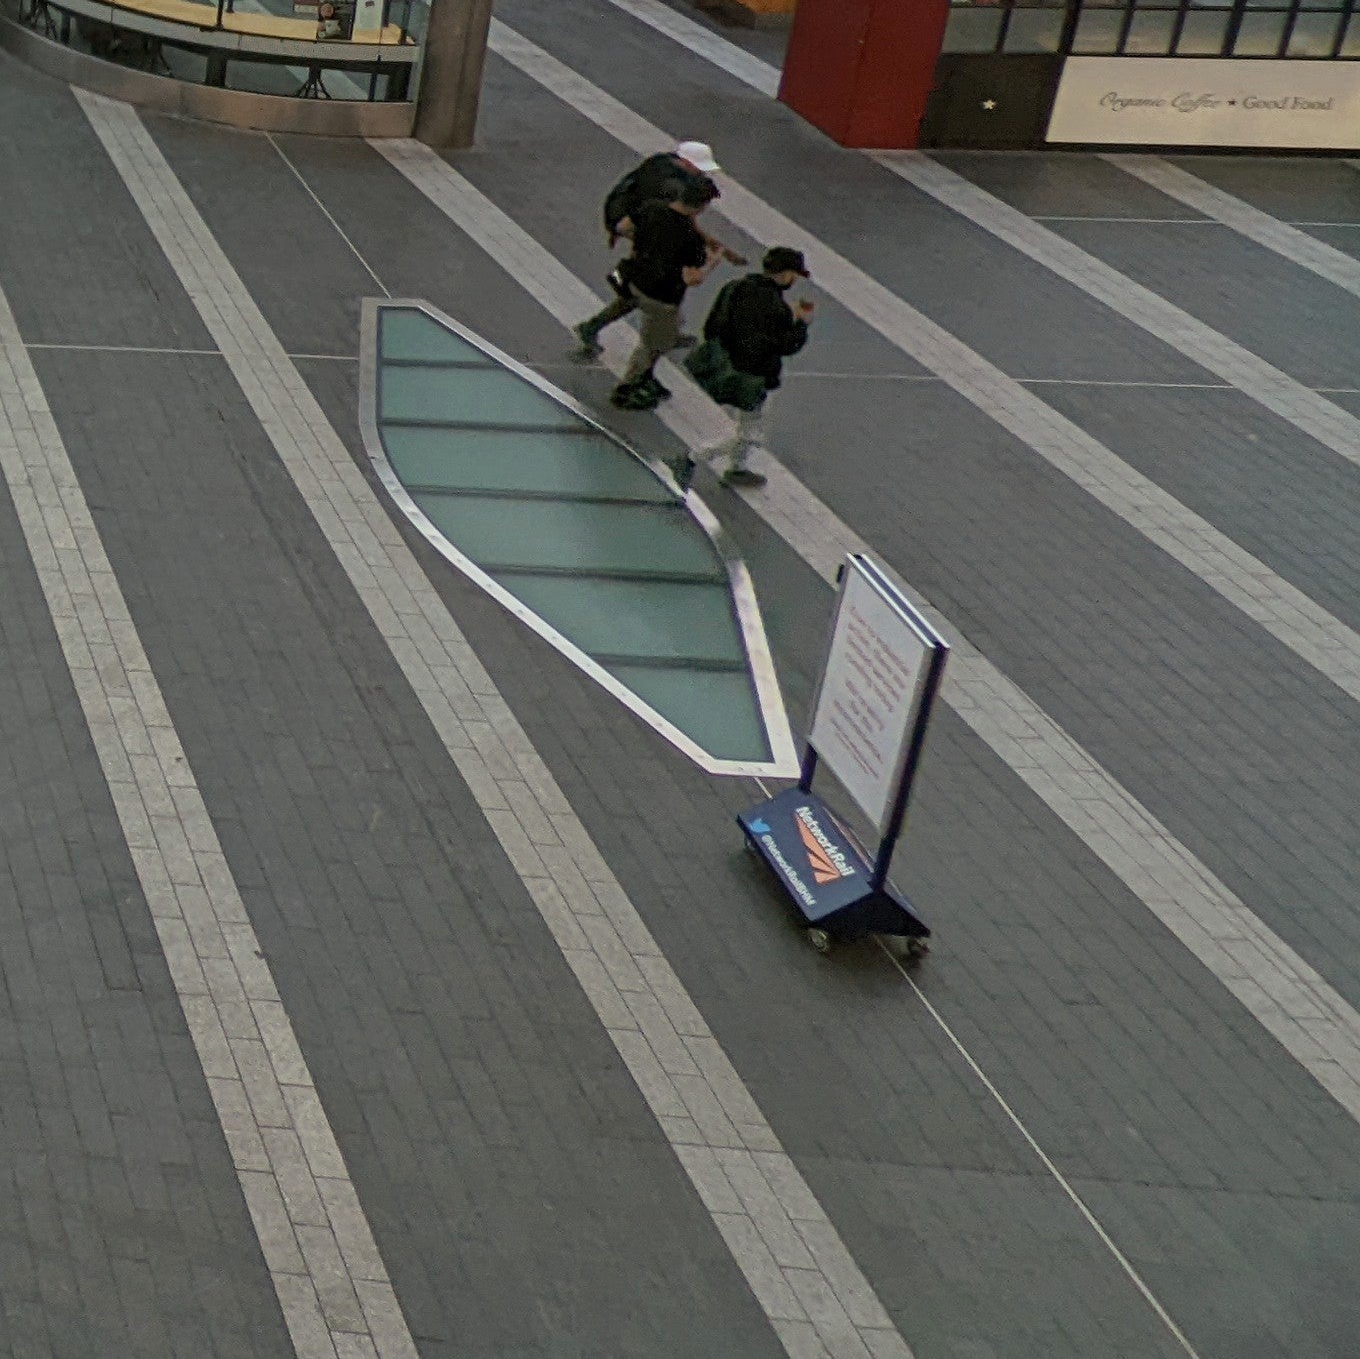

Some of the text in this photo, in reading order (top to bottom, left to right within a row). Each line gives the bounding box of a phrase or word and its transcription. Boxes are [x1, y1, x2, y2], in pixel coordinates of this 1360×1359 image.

[1099, 91, 1334, 113] Organic Coffee Good Food
[795, 806, 856, 877] NetworkRail
